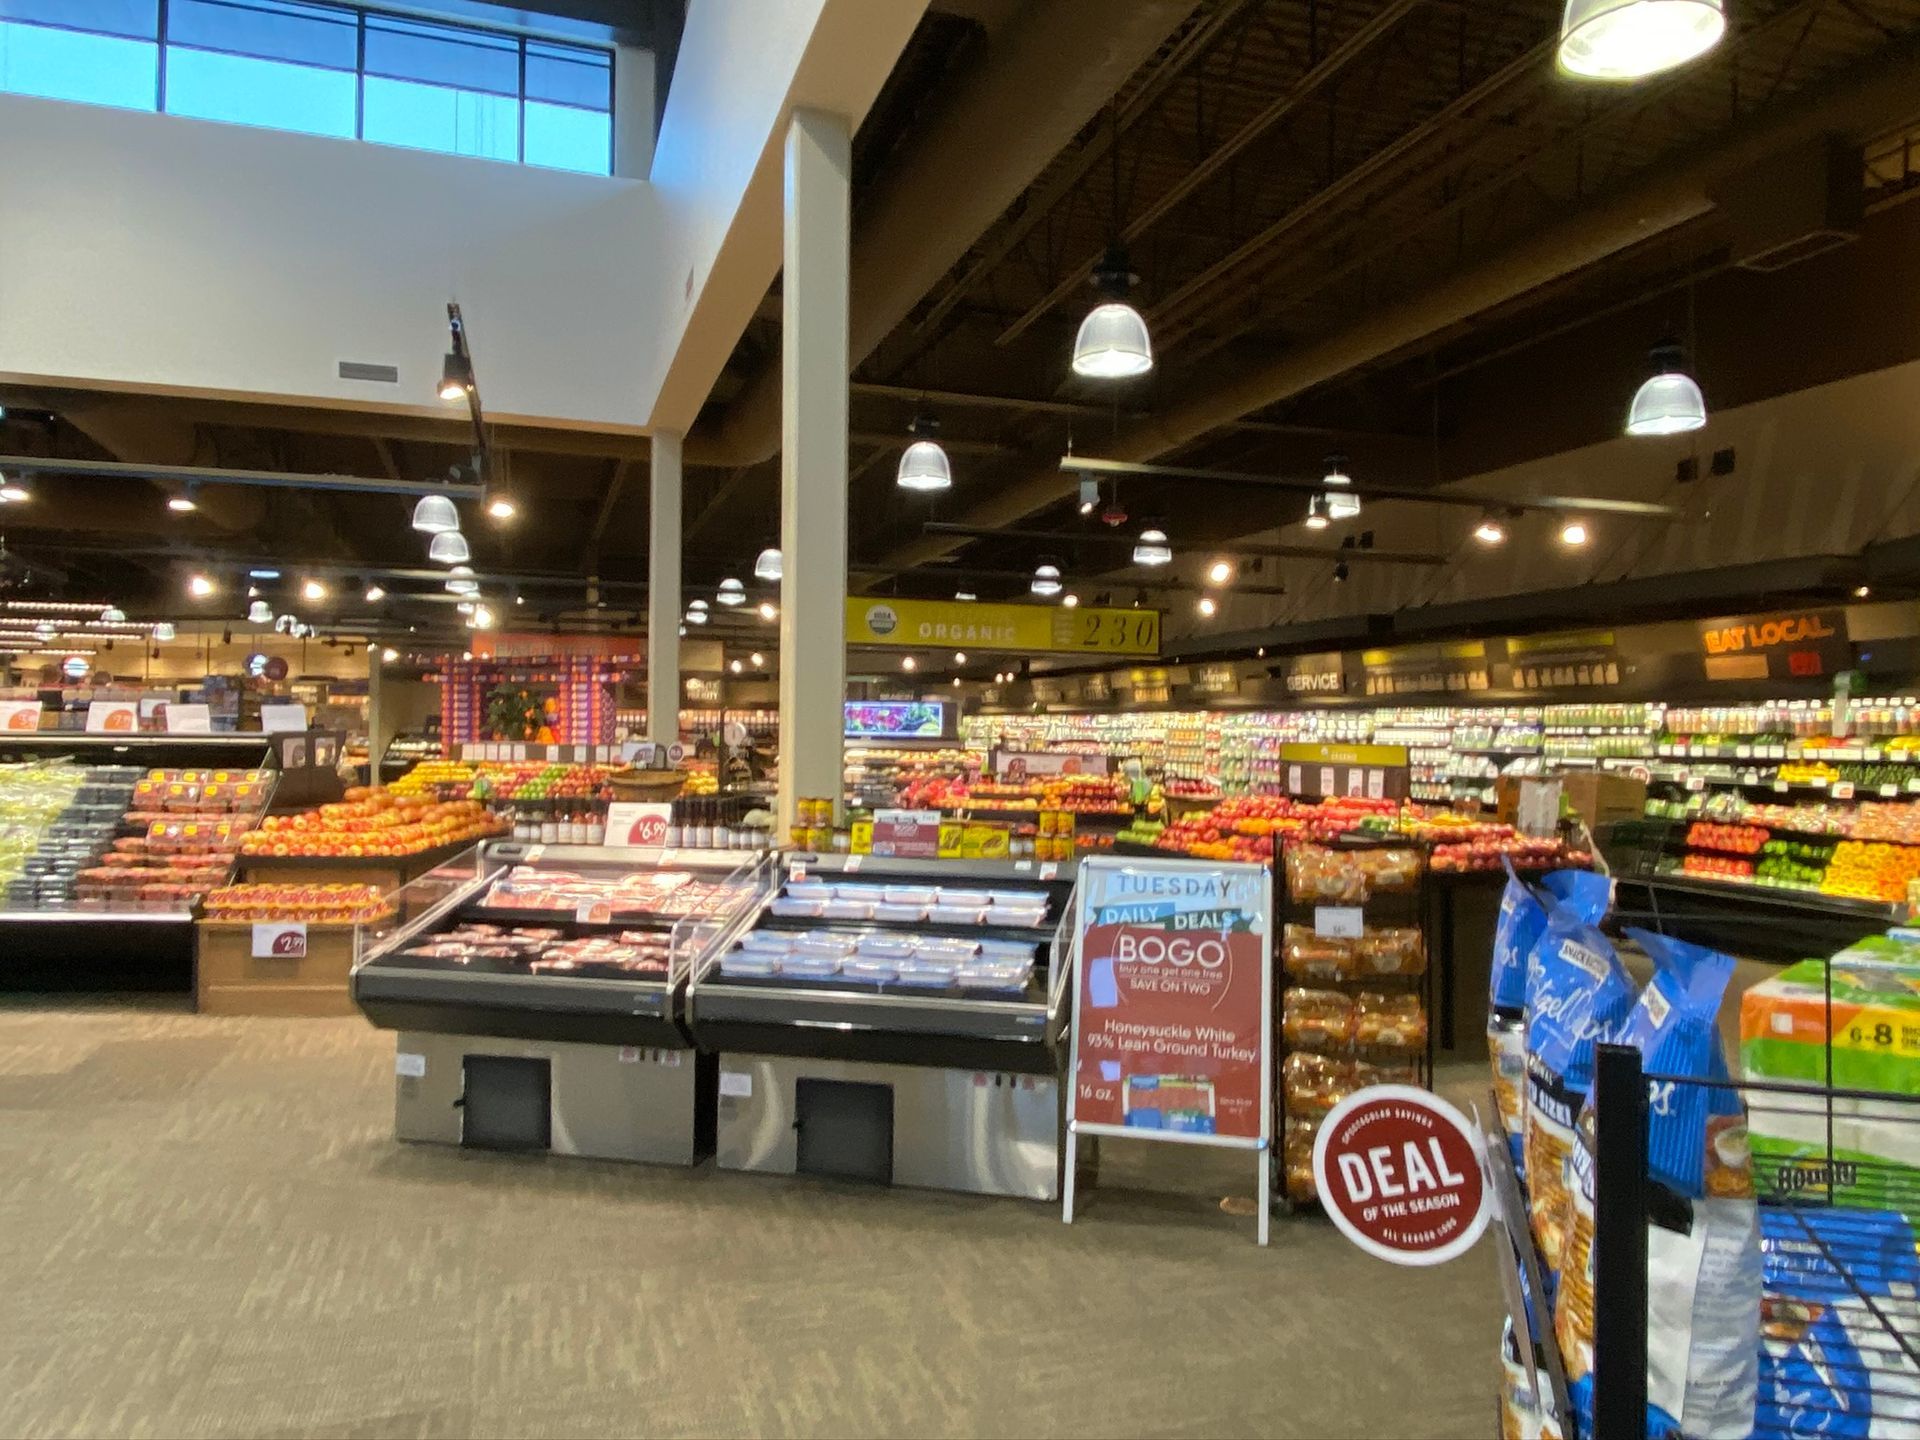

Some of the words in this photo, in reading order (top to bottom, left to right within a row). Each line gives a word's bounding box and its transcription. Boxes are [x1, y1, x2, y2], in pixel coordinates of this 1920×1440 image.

[919, 622, 1017, 642] ORGANIC
[1704, 626, 1746, 654] EAT
[1750, 616, 1835, 647] LOCAL
[1286, 671, 1339, 692] SERVICE
[639, 820, 667, 840] $6.99
[1118, 875, 1231, 897] TUESDAY
[1105, 906, 1159, 924] DAILY
[1174, 910, 1233, 930] DEALS
[1119, 935, 1224, 967] BOGO
[1119, 964, 1139, 975] buy
[1130, 978, 1158, 991] SAVE
[1160, 979, 1180, 992] ON
[1182, 980, 1210, 994] TWO
[1104, 1018, 1191, 1040] Honeysuckle
[1195, 1026, 1236, 1043] White
[1873, 1022, 1894, 1045] 8
[1087, 1032, 1114, 1047] 93%
[1117, 1036, 1150, 1052] Lean
[1154, 1040, 1207, 1058] Ground
[1212, 1042, 1256, 1063] Turkey
[1079, 1083, 1093, 1098] 16
[1095, 1088, 1115, 1102] oz.
[1394, 1107, 1434, 1129] SAVINGS
[1337, 1137, 1464, 1203] DEAL
[1363, 1206, 1380, 1222] OF
[1382, 1202, 1408, 1218] THE
[1410, 1194, 1460, 1213] SEASON
